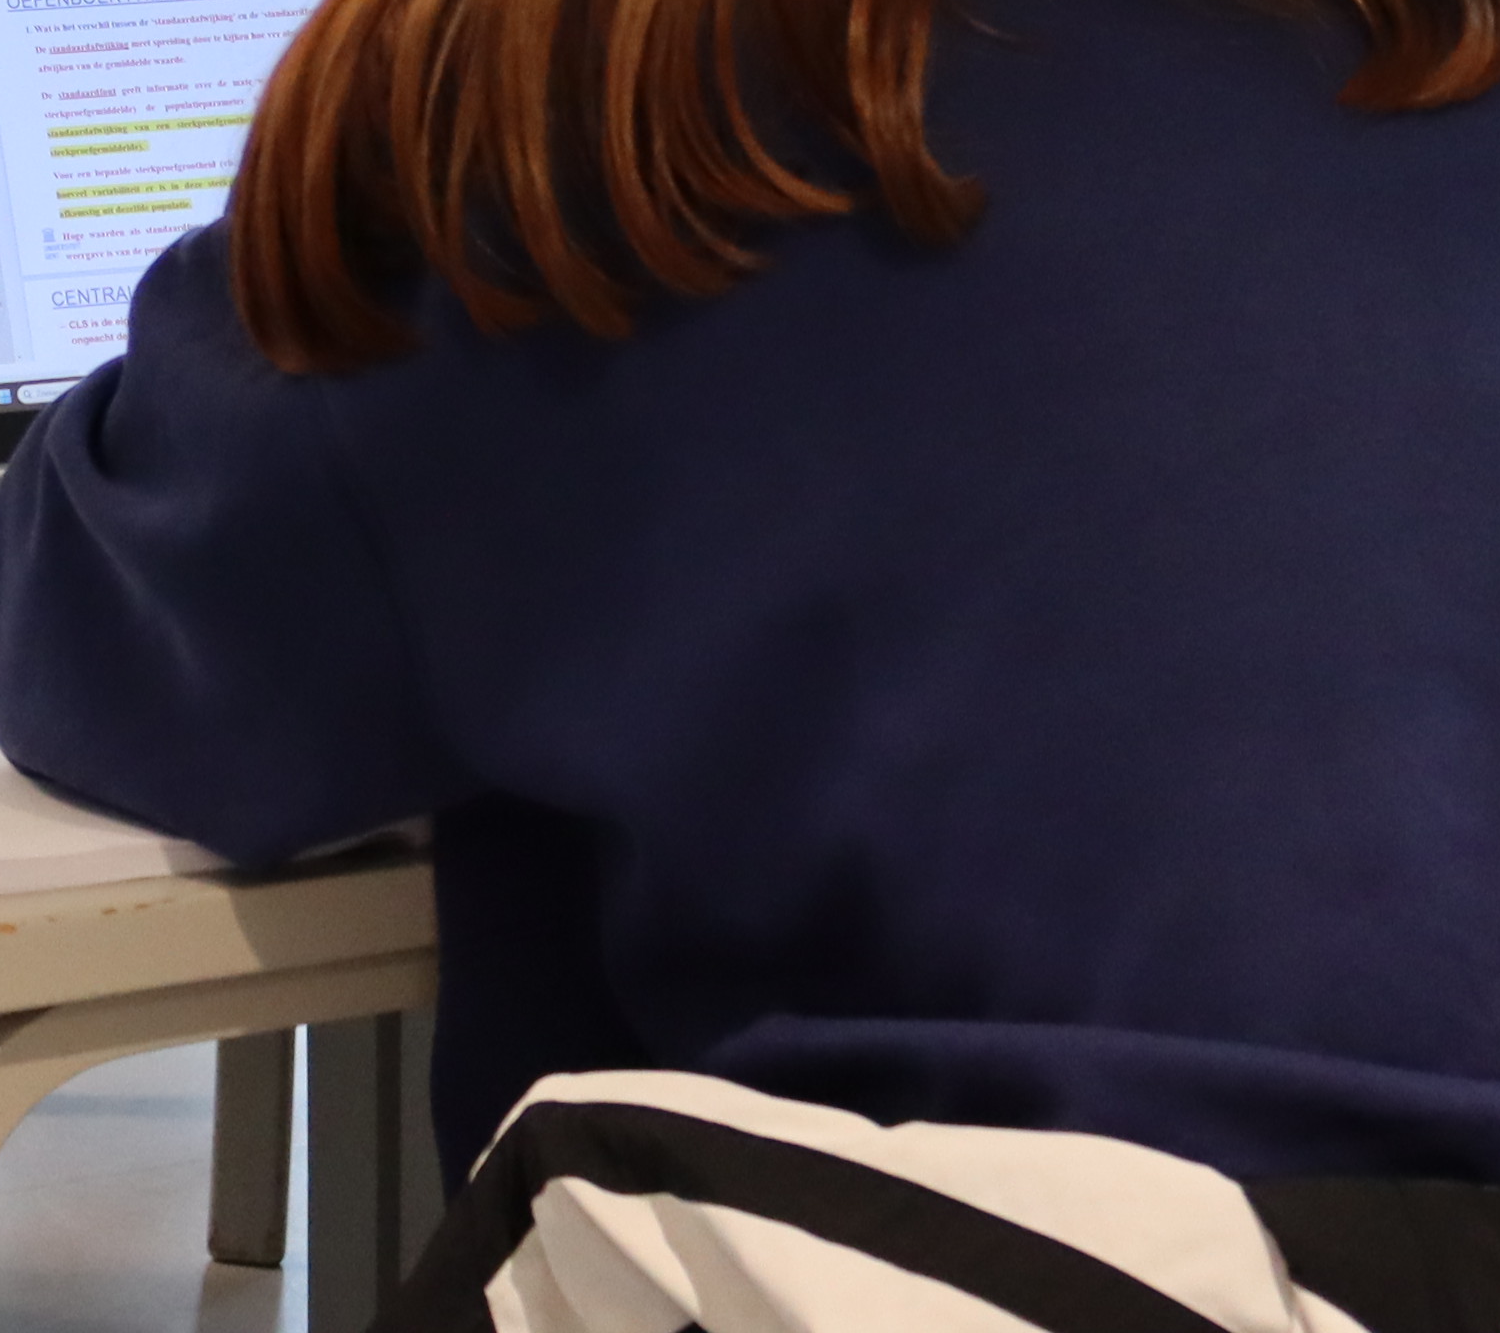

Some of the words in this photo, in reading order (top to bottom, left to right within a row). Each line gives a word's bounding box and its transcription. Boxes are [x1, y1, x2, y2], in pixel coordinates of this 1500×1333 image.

[51, 284, 132, 307] CENTRA
[69, 318, 89, 329] CLS
[102, 317, 113, 327] de
[71, 333, 114, 346] ongeacht
